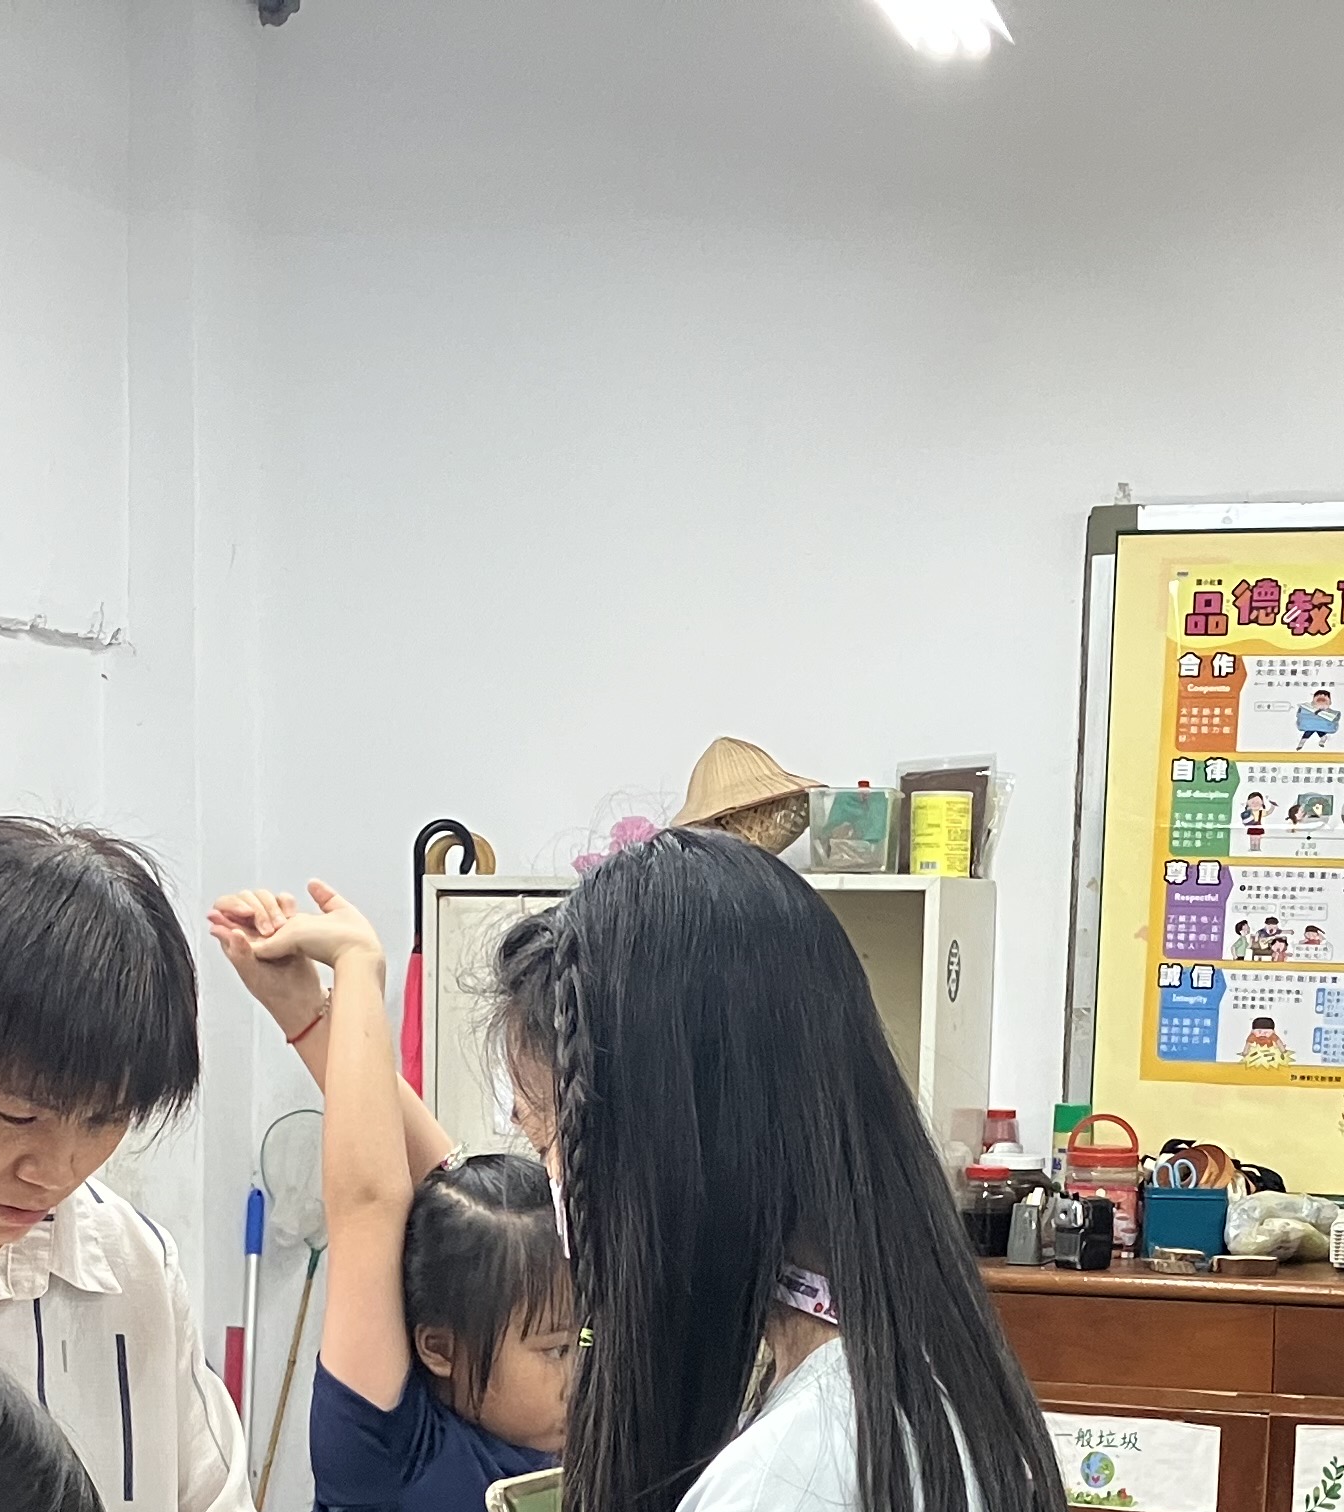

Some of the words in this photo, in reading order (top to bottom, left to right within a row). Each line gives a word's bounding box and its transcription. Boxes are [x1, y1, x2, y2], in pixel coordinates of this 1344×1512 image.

[1178, 652, 1236, 678] 合作
[1171, 757, 1229, 782] 自律
[1164, 860, 1220, 885] 尊重
[1174, 892, 1219, 905] Respectful
[1158, 963, 1214, 989] 誠信
[1172, 993, 1208, 1006] Integrity
[1053, 1427, 1143, 1452] 一般垃圾
